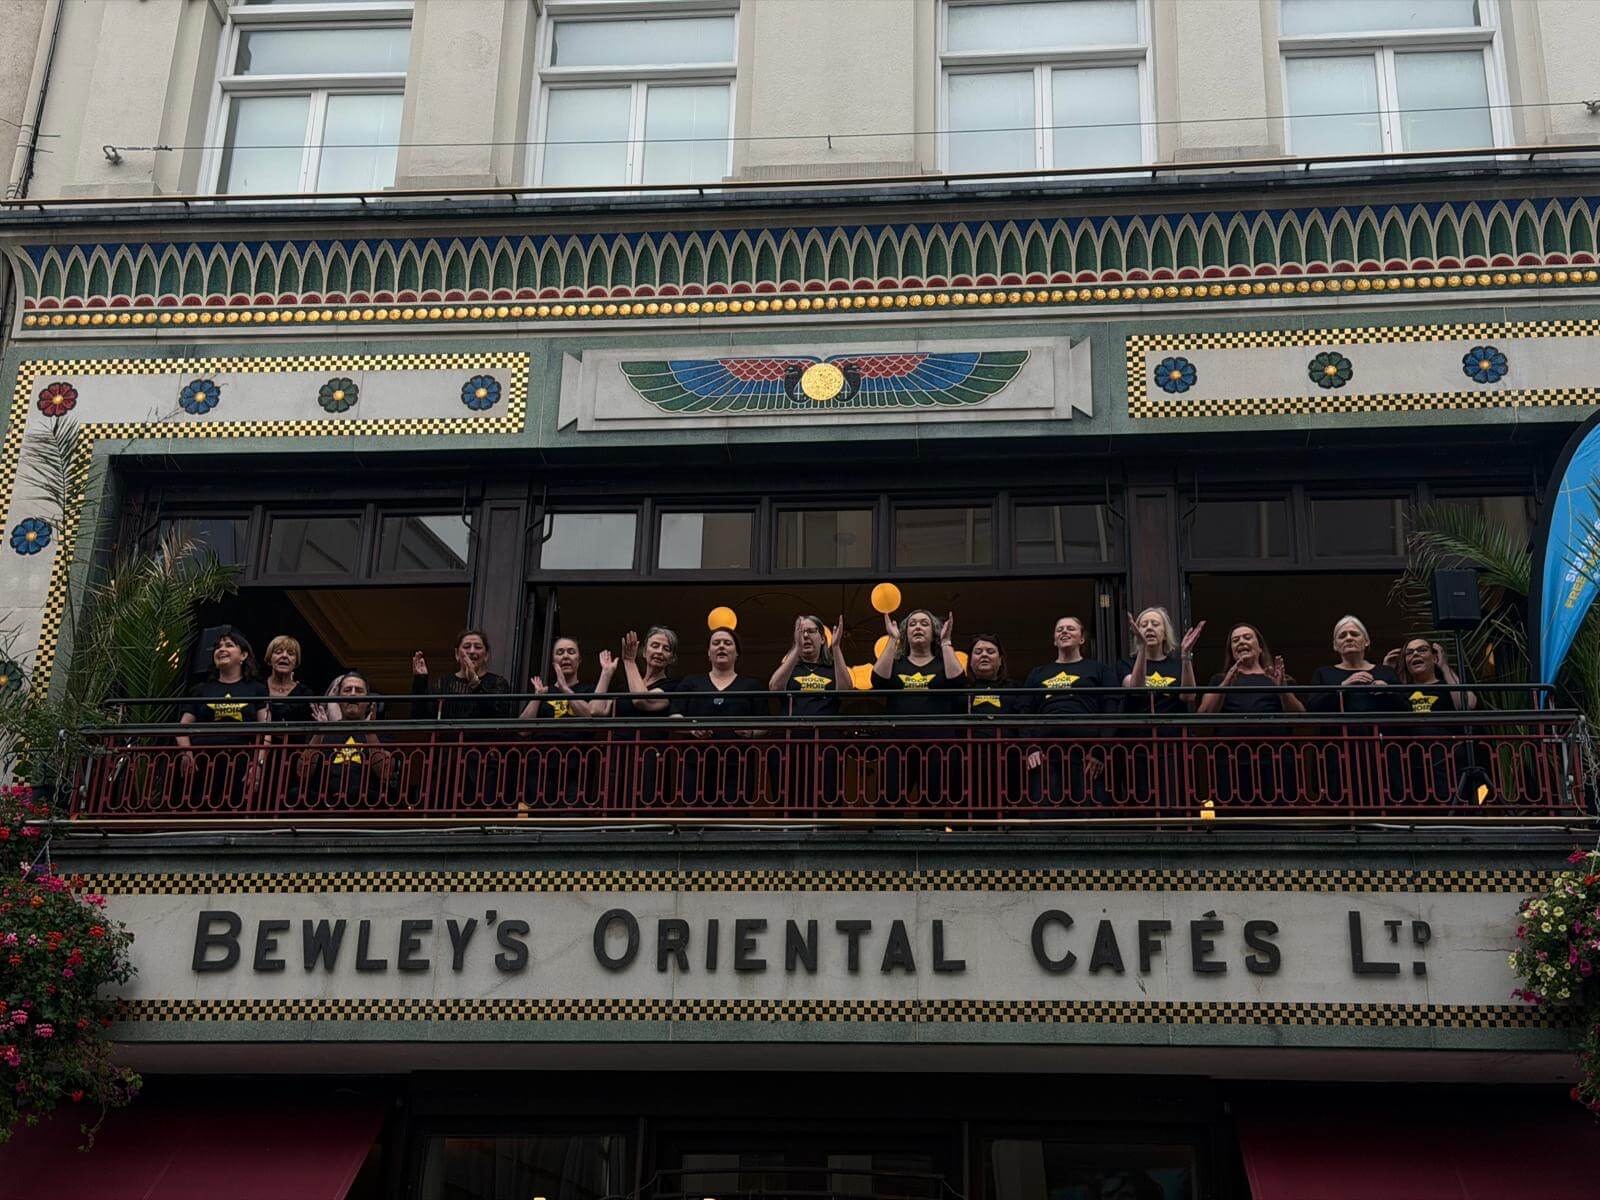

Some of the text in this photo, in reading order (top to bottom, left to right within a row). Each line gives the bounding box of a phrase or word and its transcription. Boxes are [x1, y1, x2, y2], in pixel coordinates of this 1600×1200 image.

[192, 909, 531, 973] BEWLEY'S
[593, 907, 967, 973] ORIENTAL
[1031, 908, 1282, 975] CAFÉS
